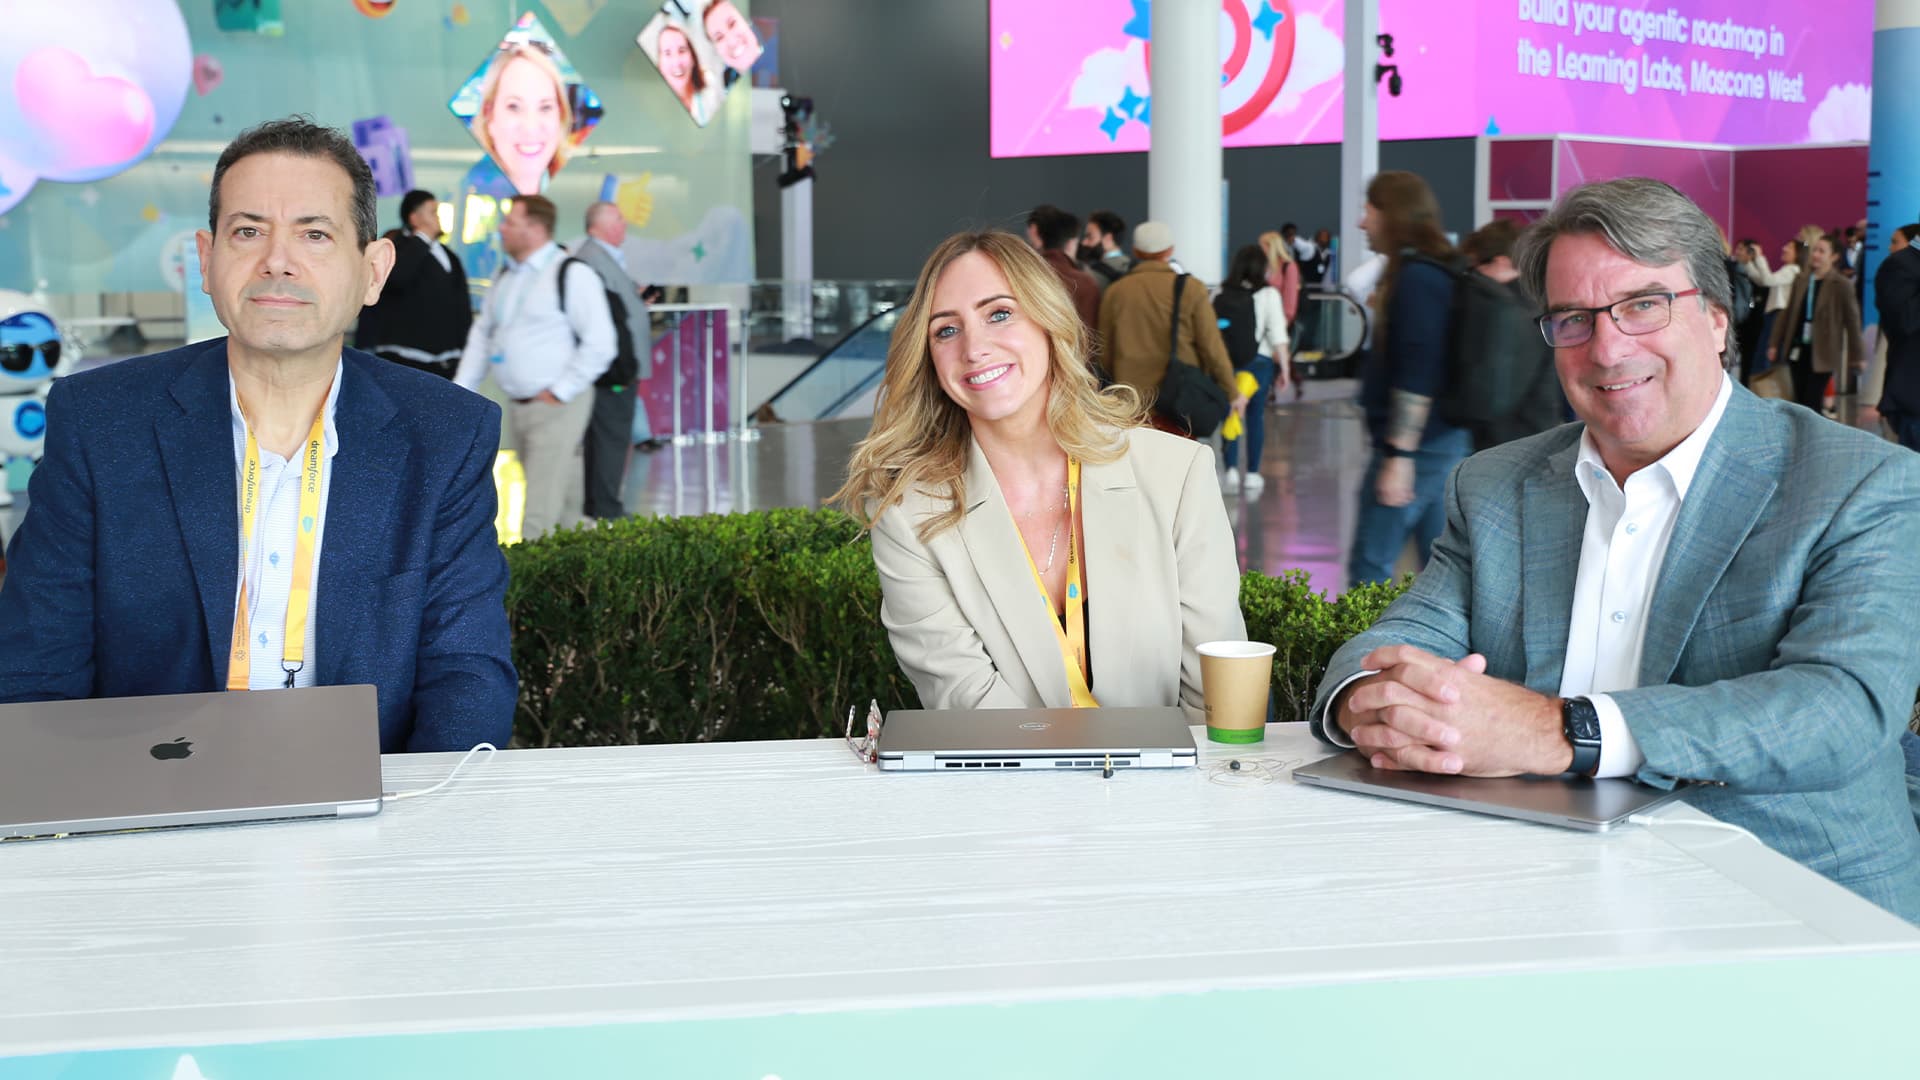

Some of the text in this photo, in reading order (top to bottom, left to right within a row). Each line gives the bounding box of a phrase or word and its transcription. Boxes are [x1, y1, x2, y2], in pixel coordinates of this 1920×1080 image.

[1573, 1, 1616, 36] your
[1619, 9, 1688, 46] agentic
[1691, 18, 1767, 60] roadmap
[1770, 24, 1785, 56] in
[1517, 38, 1806, 103] the Learning Labs, Moscone West.
[244, 458, 256, 513] dreamforce
[307, 440, 320, 493] dreamforce
